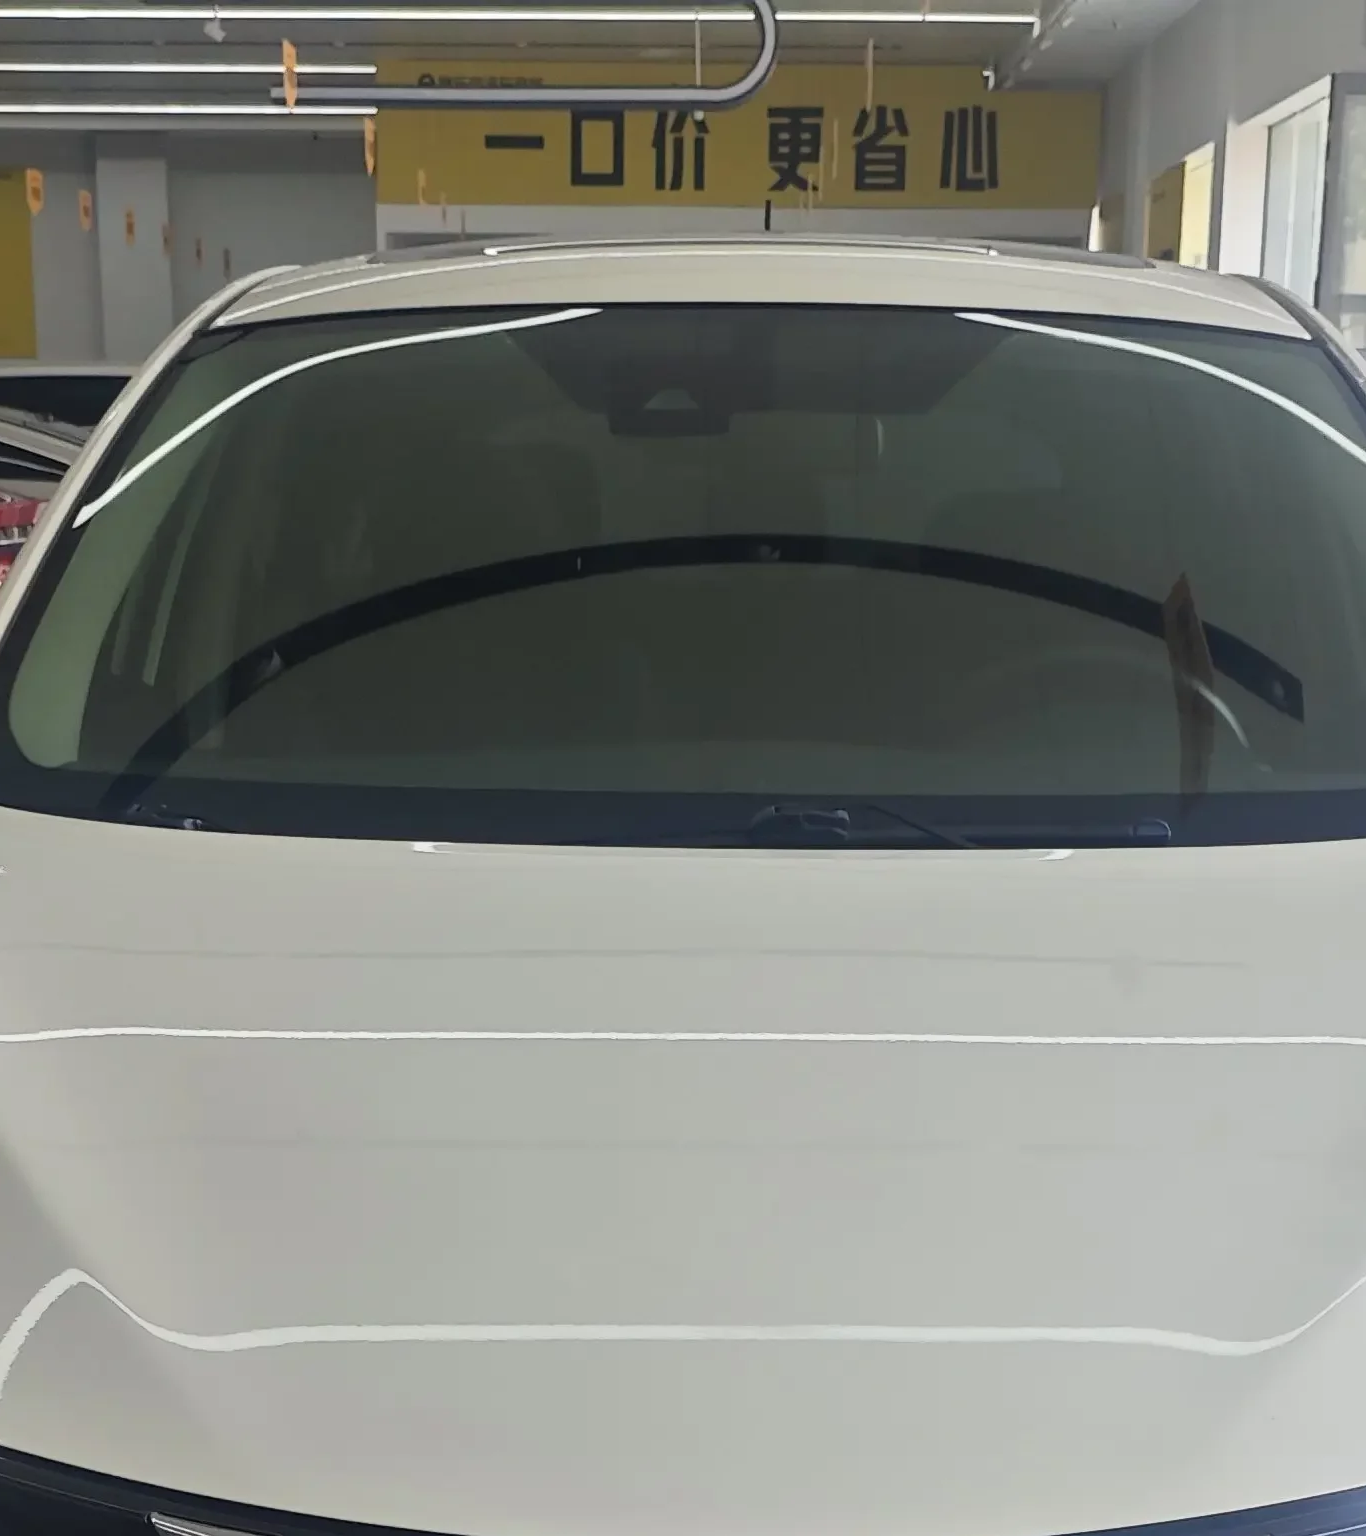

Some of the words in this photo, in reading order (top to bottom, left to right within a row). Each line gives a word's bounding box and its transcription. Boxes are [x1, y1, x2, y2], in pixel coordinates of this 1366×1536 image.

[484, 108, 711, 192] 一口价
[766, 104, 999, 193] 更省心
